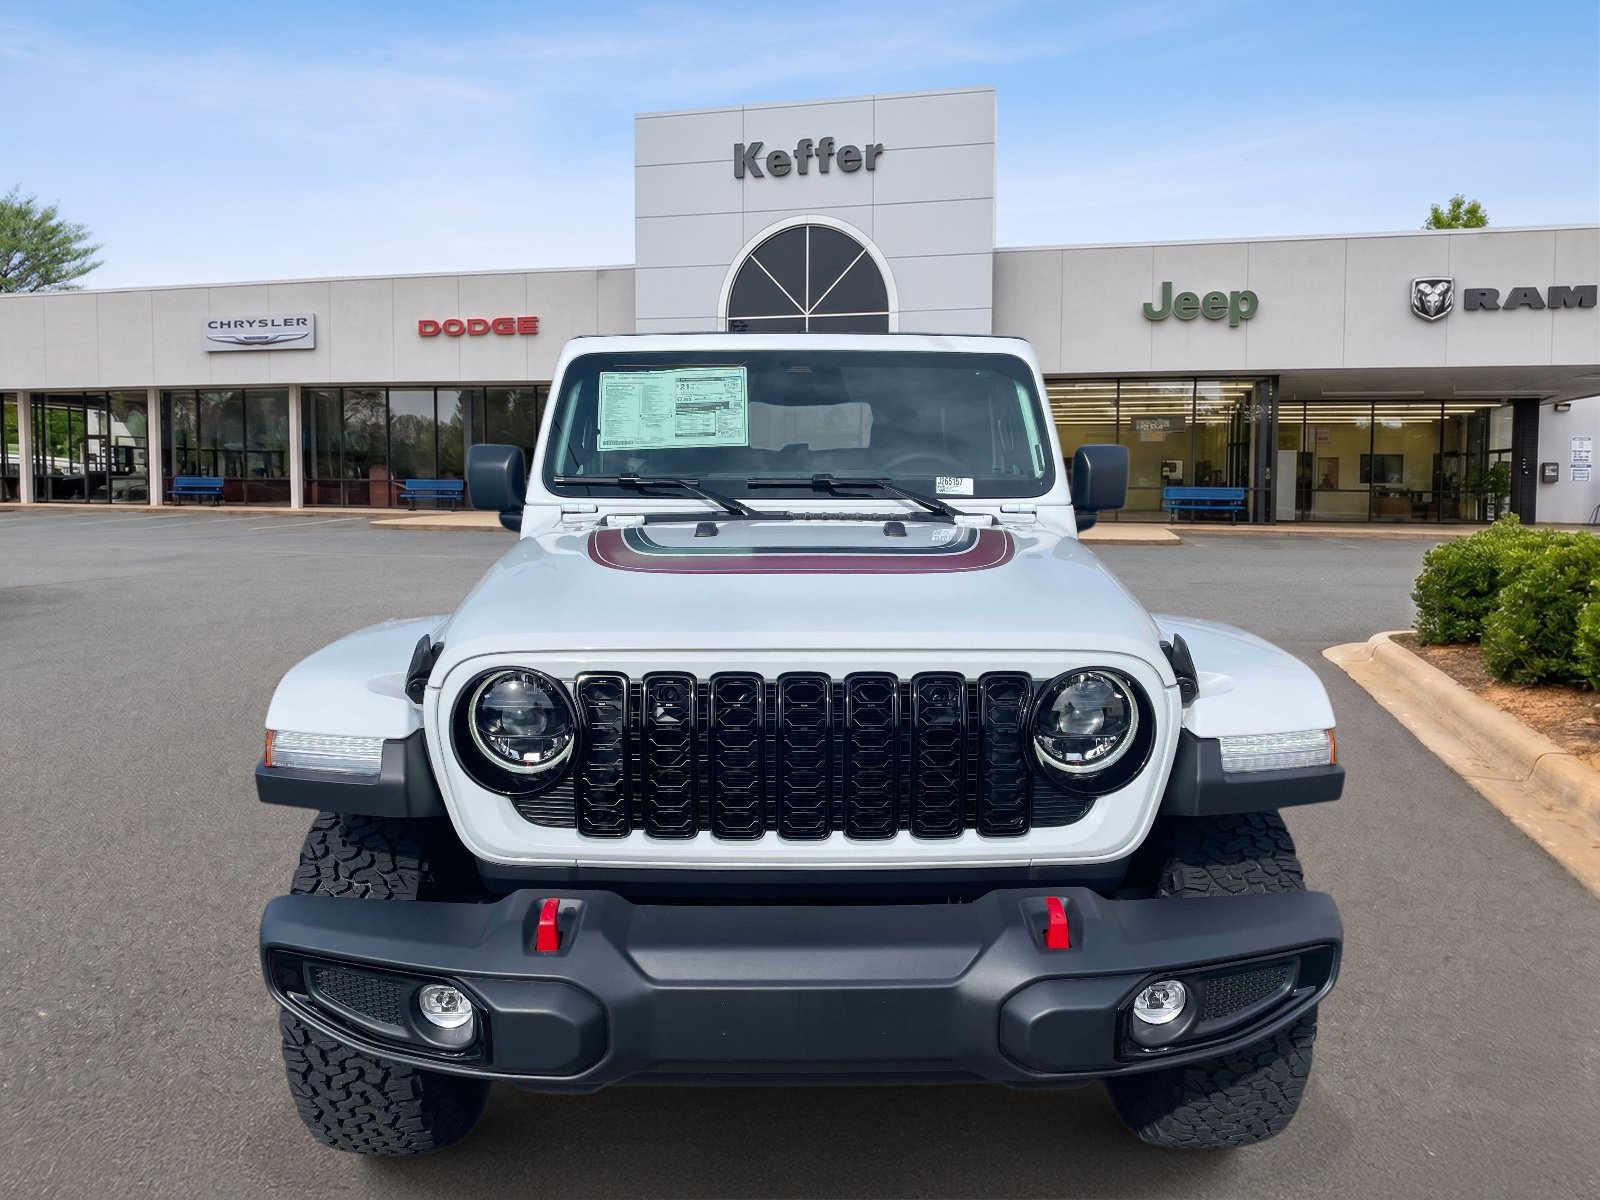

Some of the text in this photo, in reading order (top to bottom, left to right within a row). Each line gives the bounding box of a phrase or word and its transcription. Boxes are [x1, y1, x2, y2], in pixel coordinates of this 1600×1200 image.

[734, 136, 883, 178] Keffer
[1143, 281, 1259, 327] Jeep
[1464, 285, 1598, 310] RAM
[207, 317, 308, 330] CHRYSLER
[418, 316, 539, 337] DODGE
